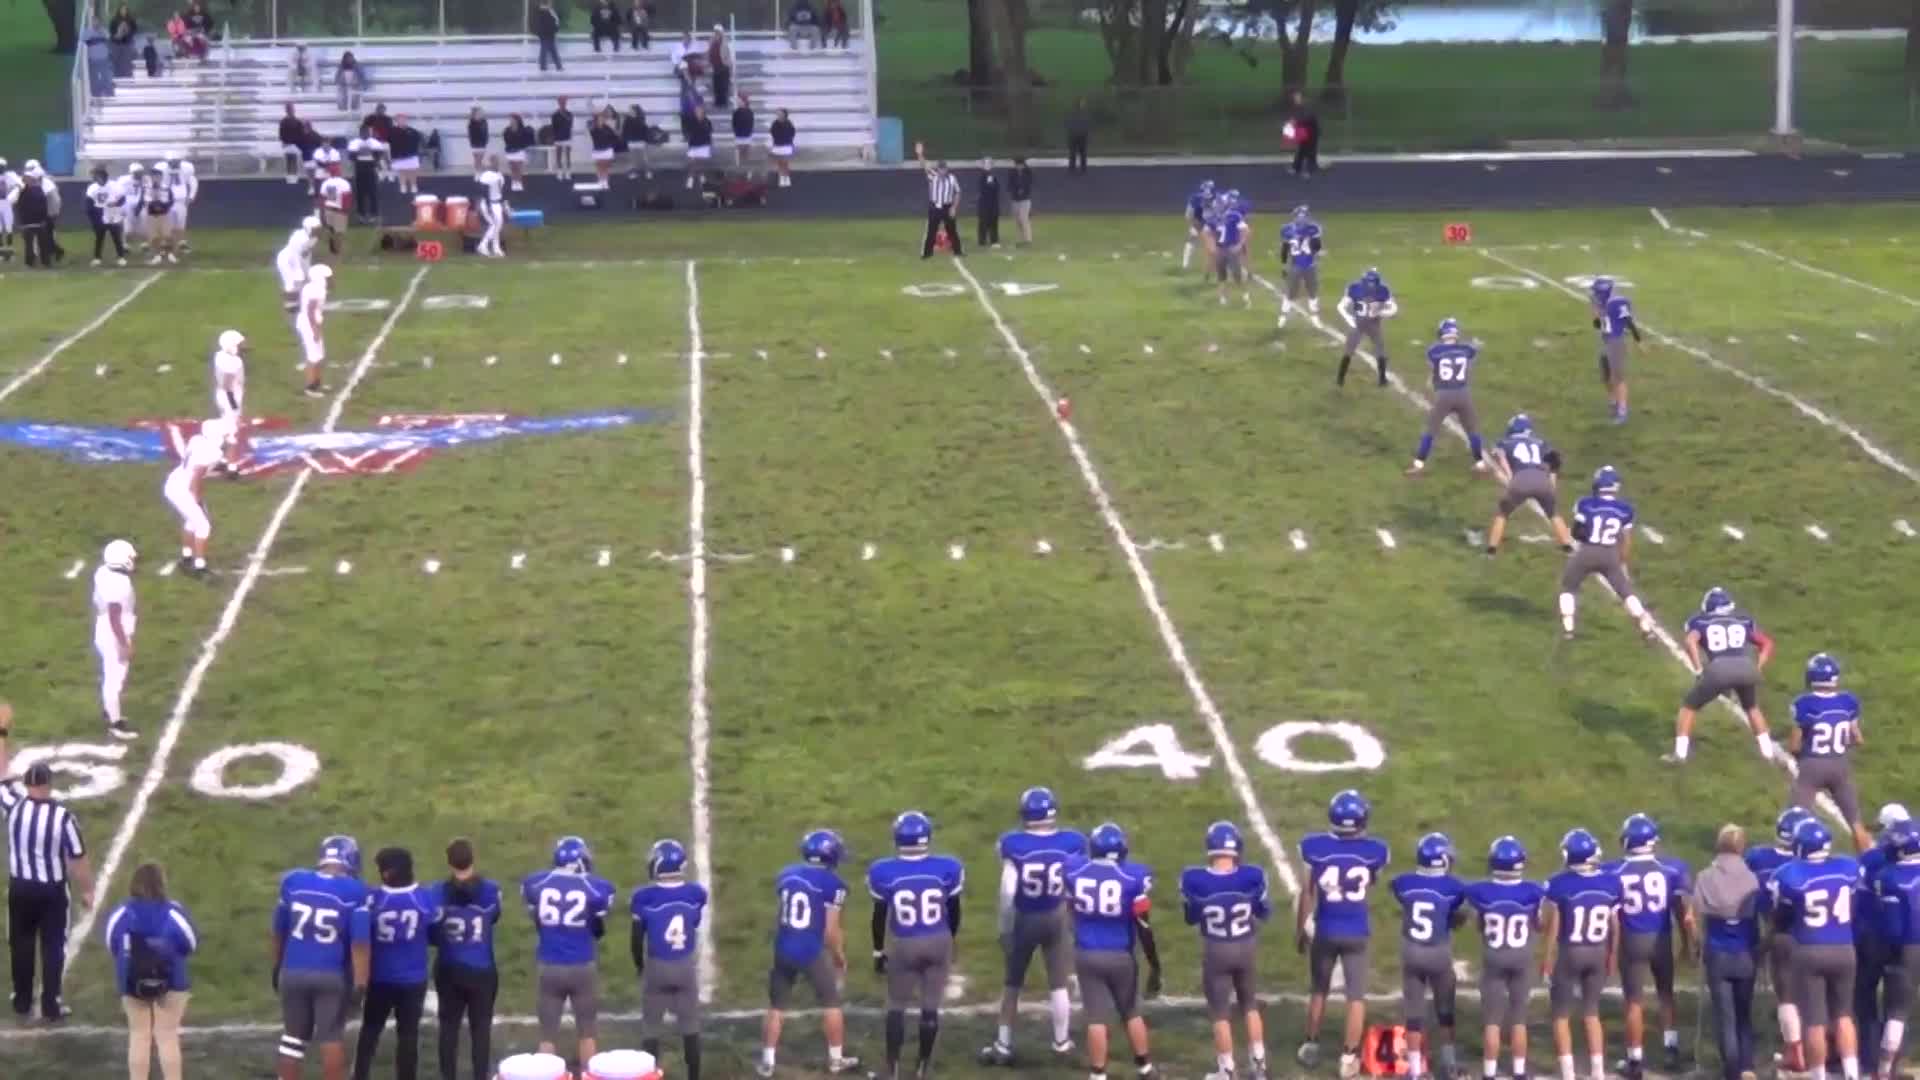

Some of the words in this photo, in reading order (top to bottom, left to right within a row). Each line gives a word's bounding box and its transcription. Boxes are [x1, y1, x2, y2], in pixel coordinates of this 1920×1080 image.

[419, 244, 438, 259] 50
[1449, 226, 1467, 241] 30
[1439, 357, 1467, 382] 67
[1513, 442, 1541, 465] 41
[1589, 515, 1621, 545] 12
[1706, 623, 1746, 652] 88
[1083, 720, 1386, 780] 40
[1811, 721, 1851, 755] 20
[1074, 877, 1122, 916] 58
[1318, 865, 1371, 903] 43
[1620, 871, 1667, 914] 59
[291, 901, 340, 944] 75
[377, 909, 419, 942] 57
[538, 887, 587, 927] 62
[782, 889, 812, 930] 10
[893, 888, 943, 927] 66
[1203, 902, 1252, 937] 22
[1409, 901, 1435, 941] 5
[1569, 904, 1611, 943] 18
[1803, 885, 1851, 928] 54
[664, 913, 687, 950] 4
